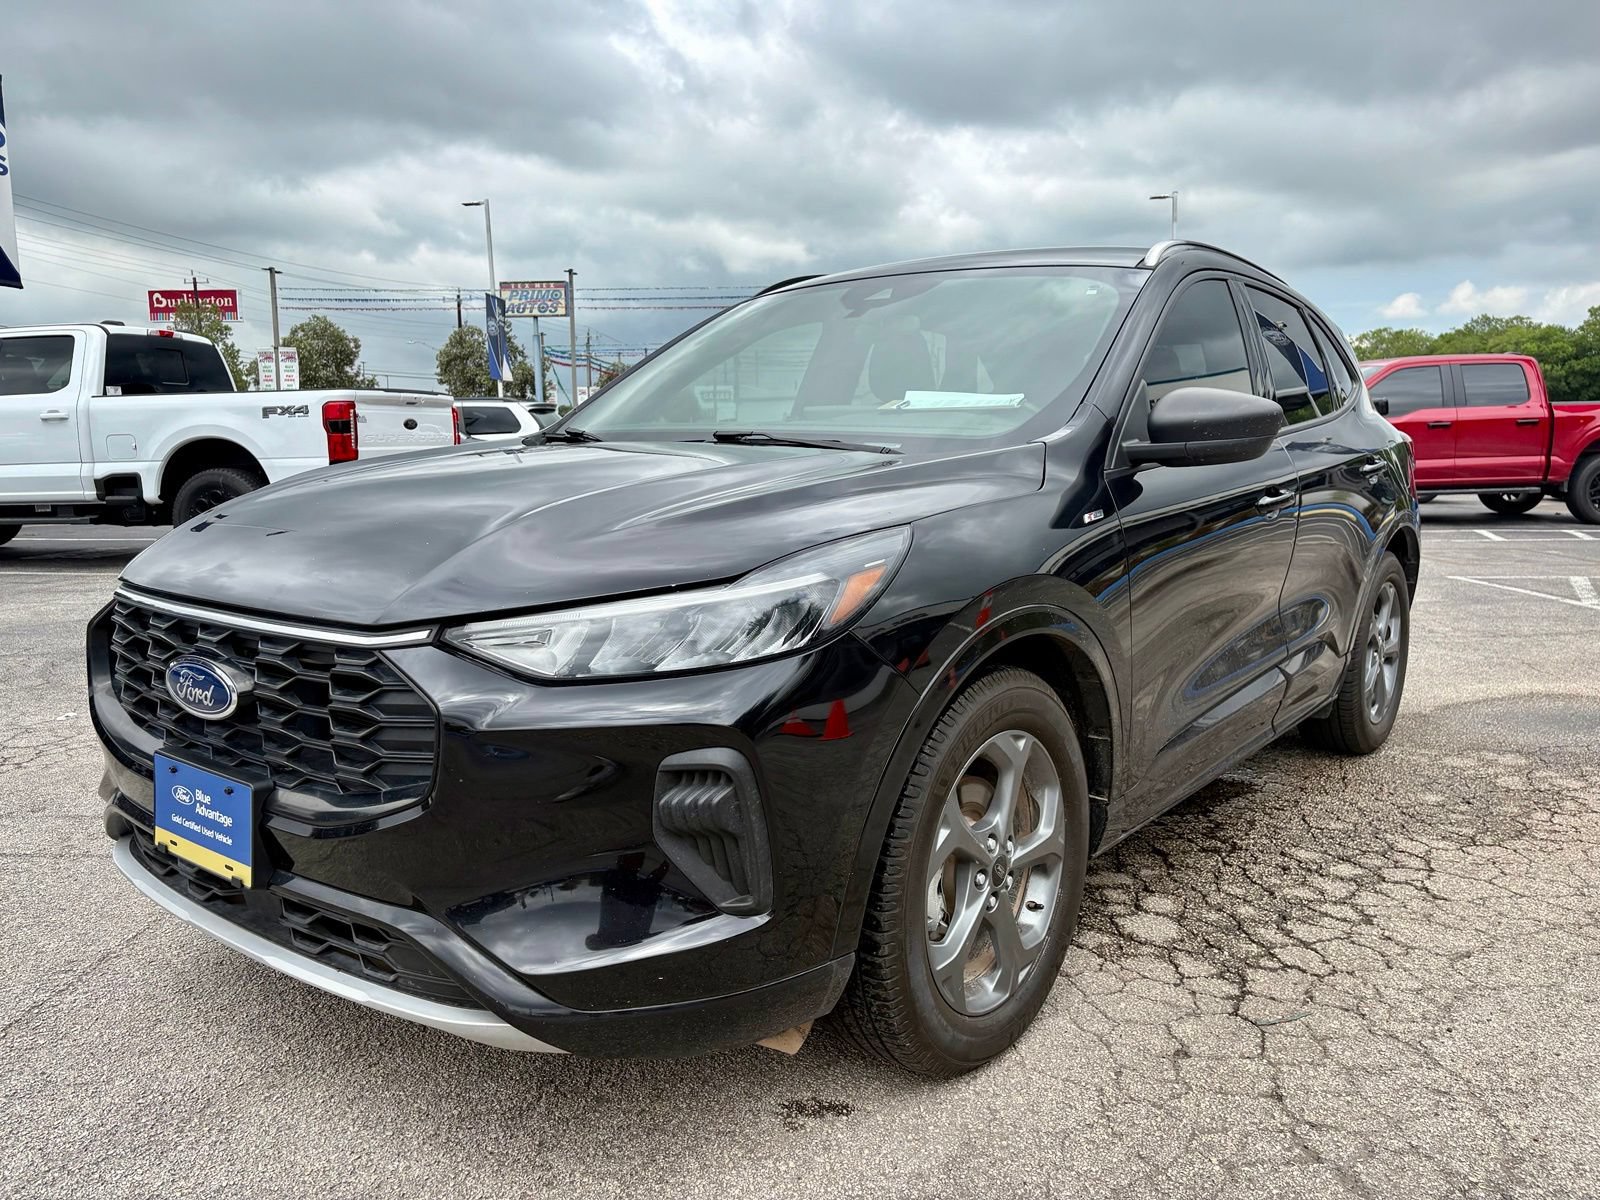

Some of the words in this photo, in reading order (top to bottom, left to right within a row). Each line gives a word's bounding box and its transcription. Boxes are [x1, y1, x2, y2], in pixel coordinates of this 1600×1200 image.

[508, 289, 563, 301] PRIMO
[505, 302, 559, 314] AUTOS
[262, 405, 309, 419] FX4
[177, 669, 215, 706] Ford
[175, 787, 191, 803] Ford
[195, 788, 211, 805] Blue
[195, 803, 233, 827] Advantage
[171, 813, 182, 825] Gold
[182, 818, 201, 833] Certified
[201, 826, 215, 838] Used
[214, 831, 233, 846] Vehicle
